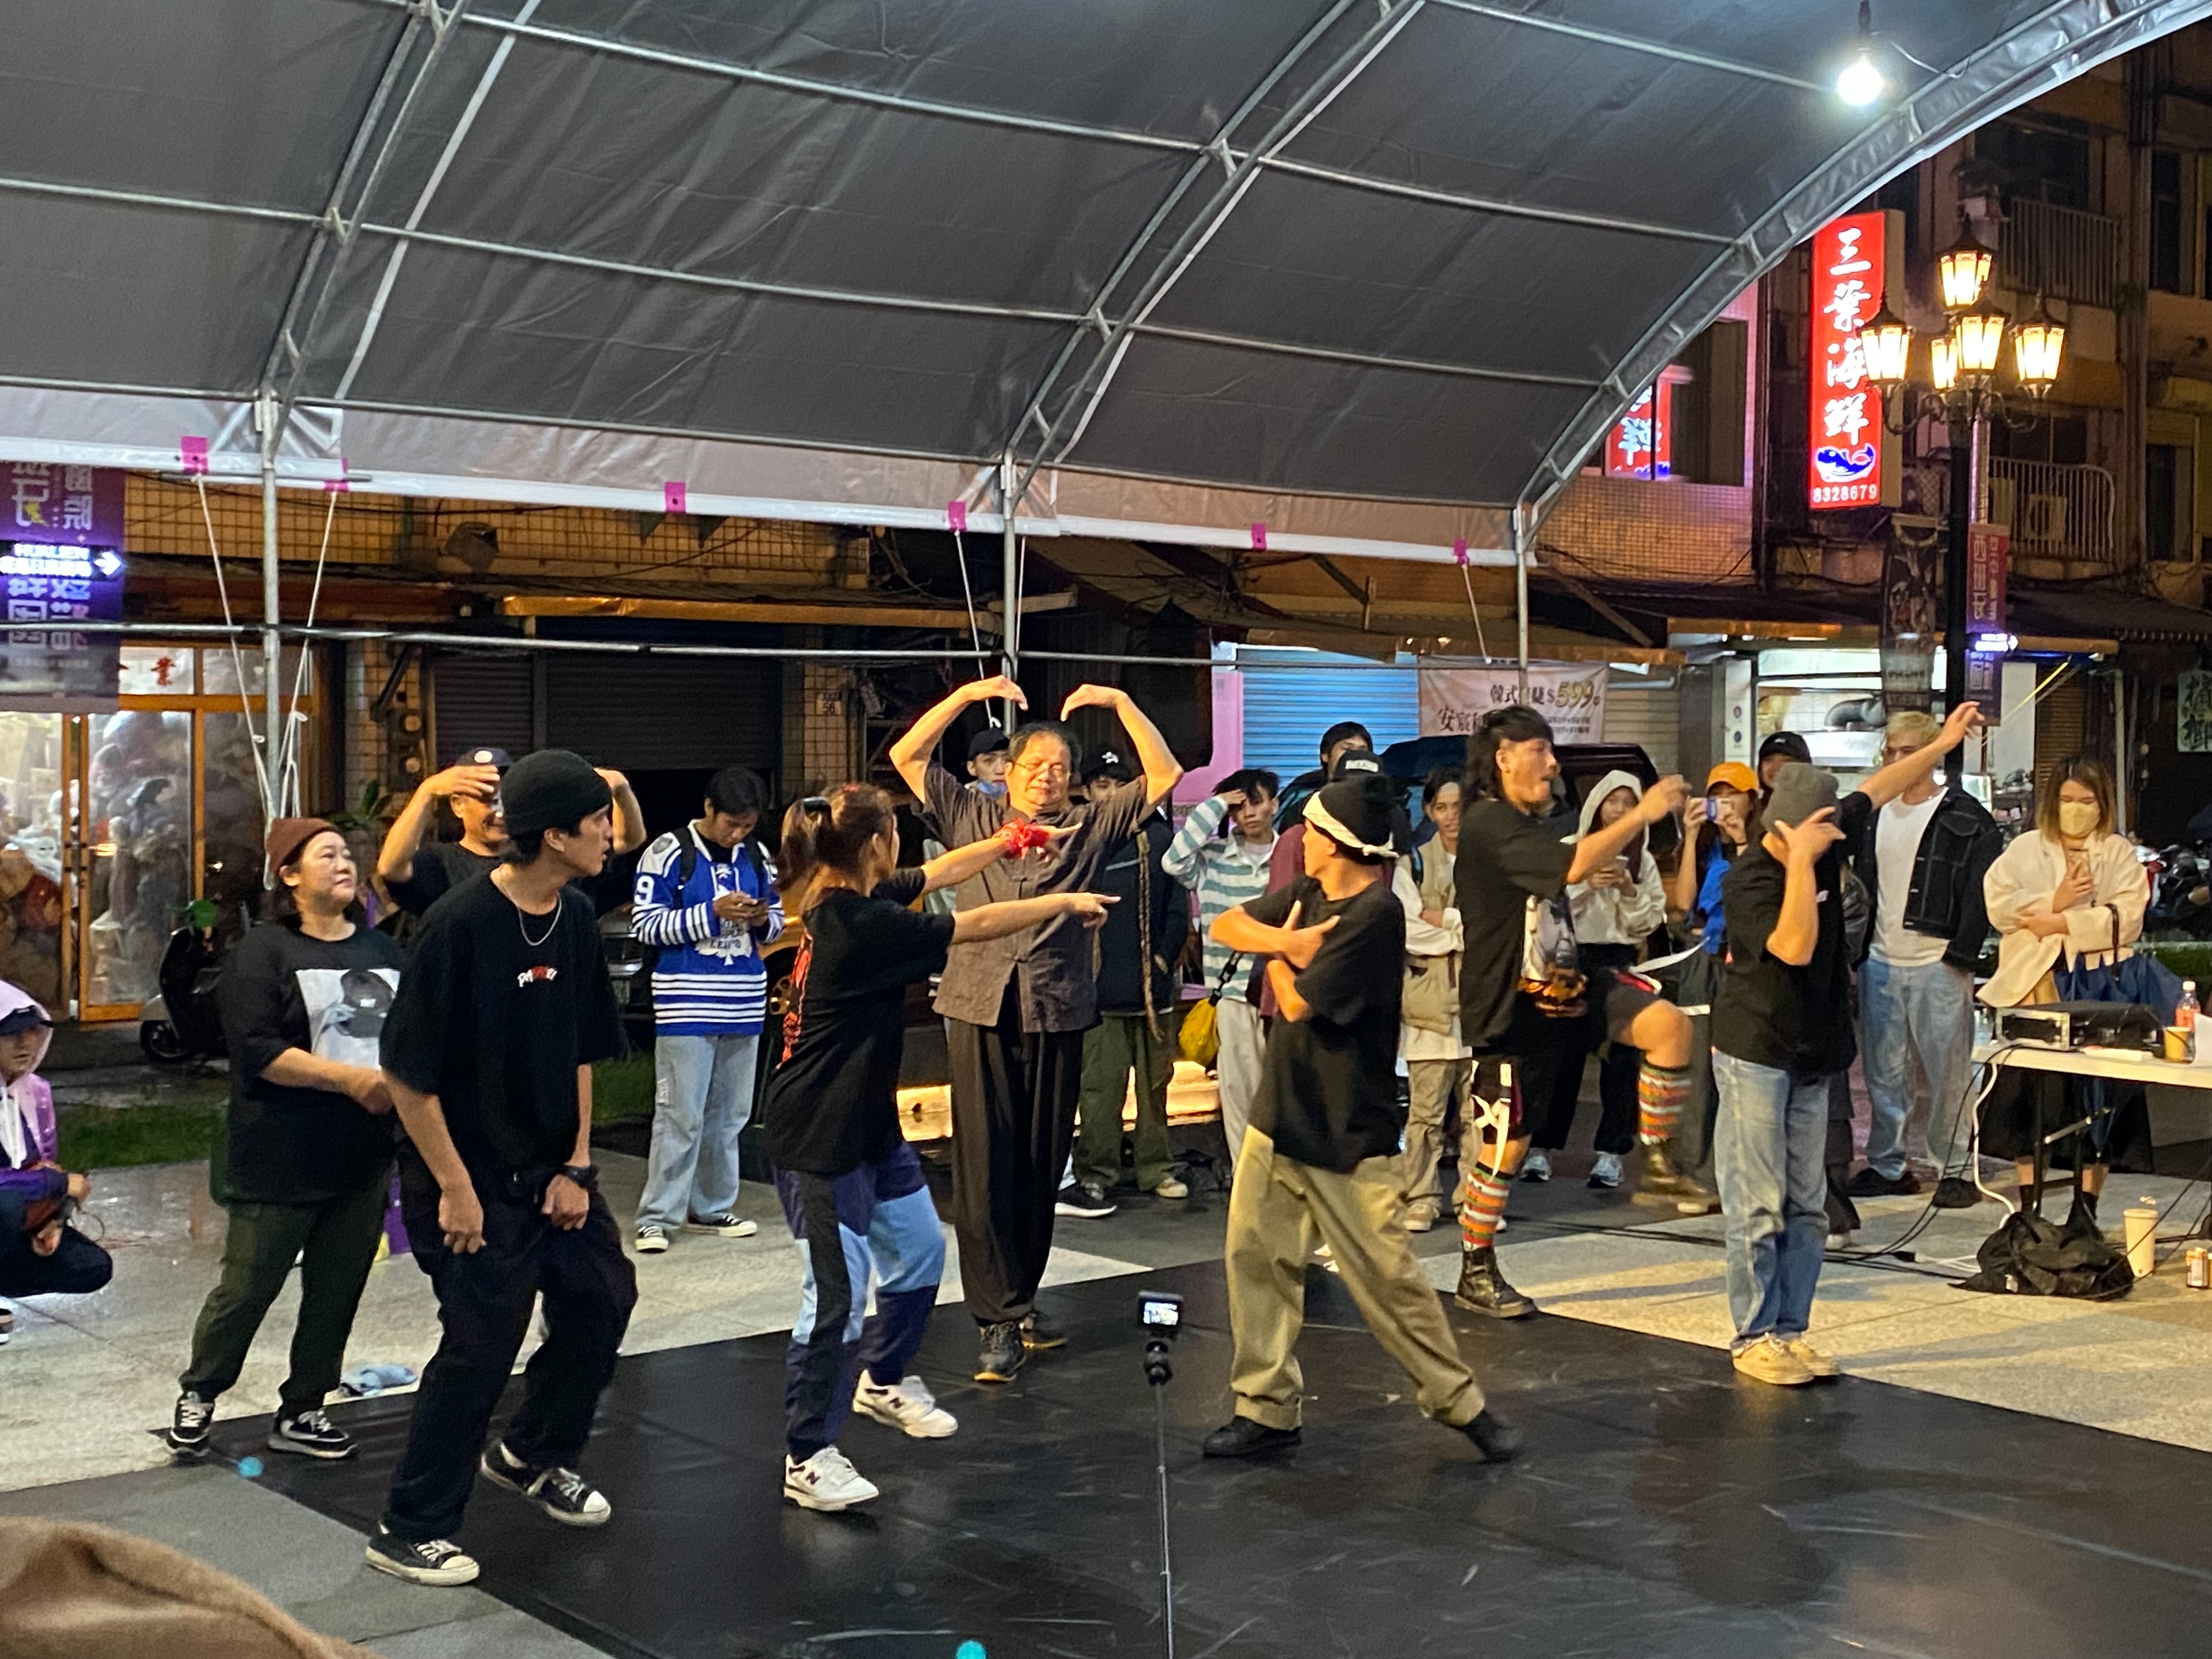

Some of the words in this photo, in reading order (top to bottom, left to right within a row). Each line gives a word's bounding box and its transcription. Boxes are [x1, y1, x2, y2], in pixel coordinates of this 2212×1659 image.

[1823, 228, 1872, 445] 三葉海鮮
[1813, 484, 1877, 503] 8328679
[1491, 684, 1544, 704] 韓式睫
